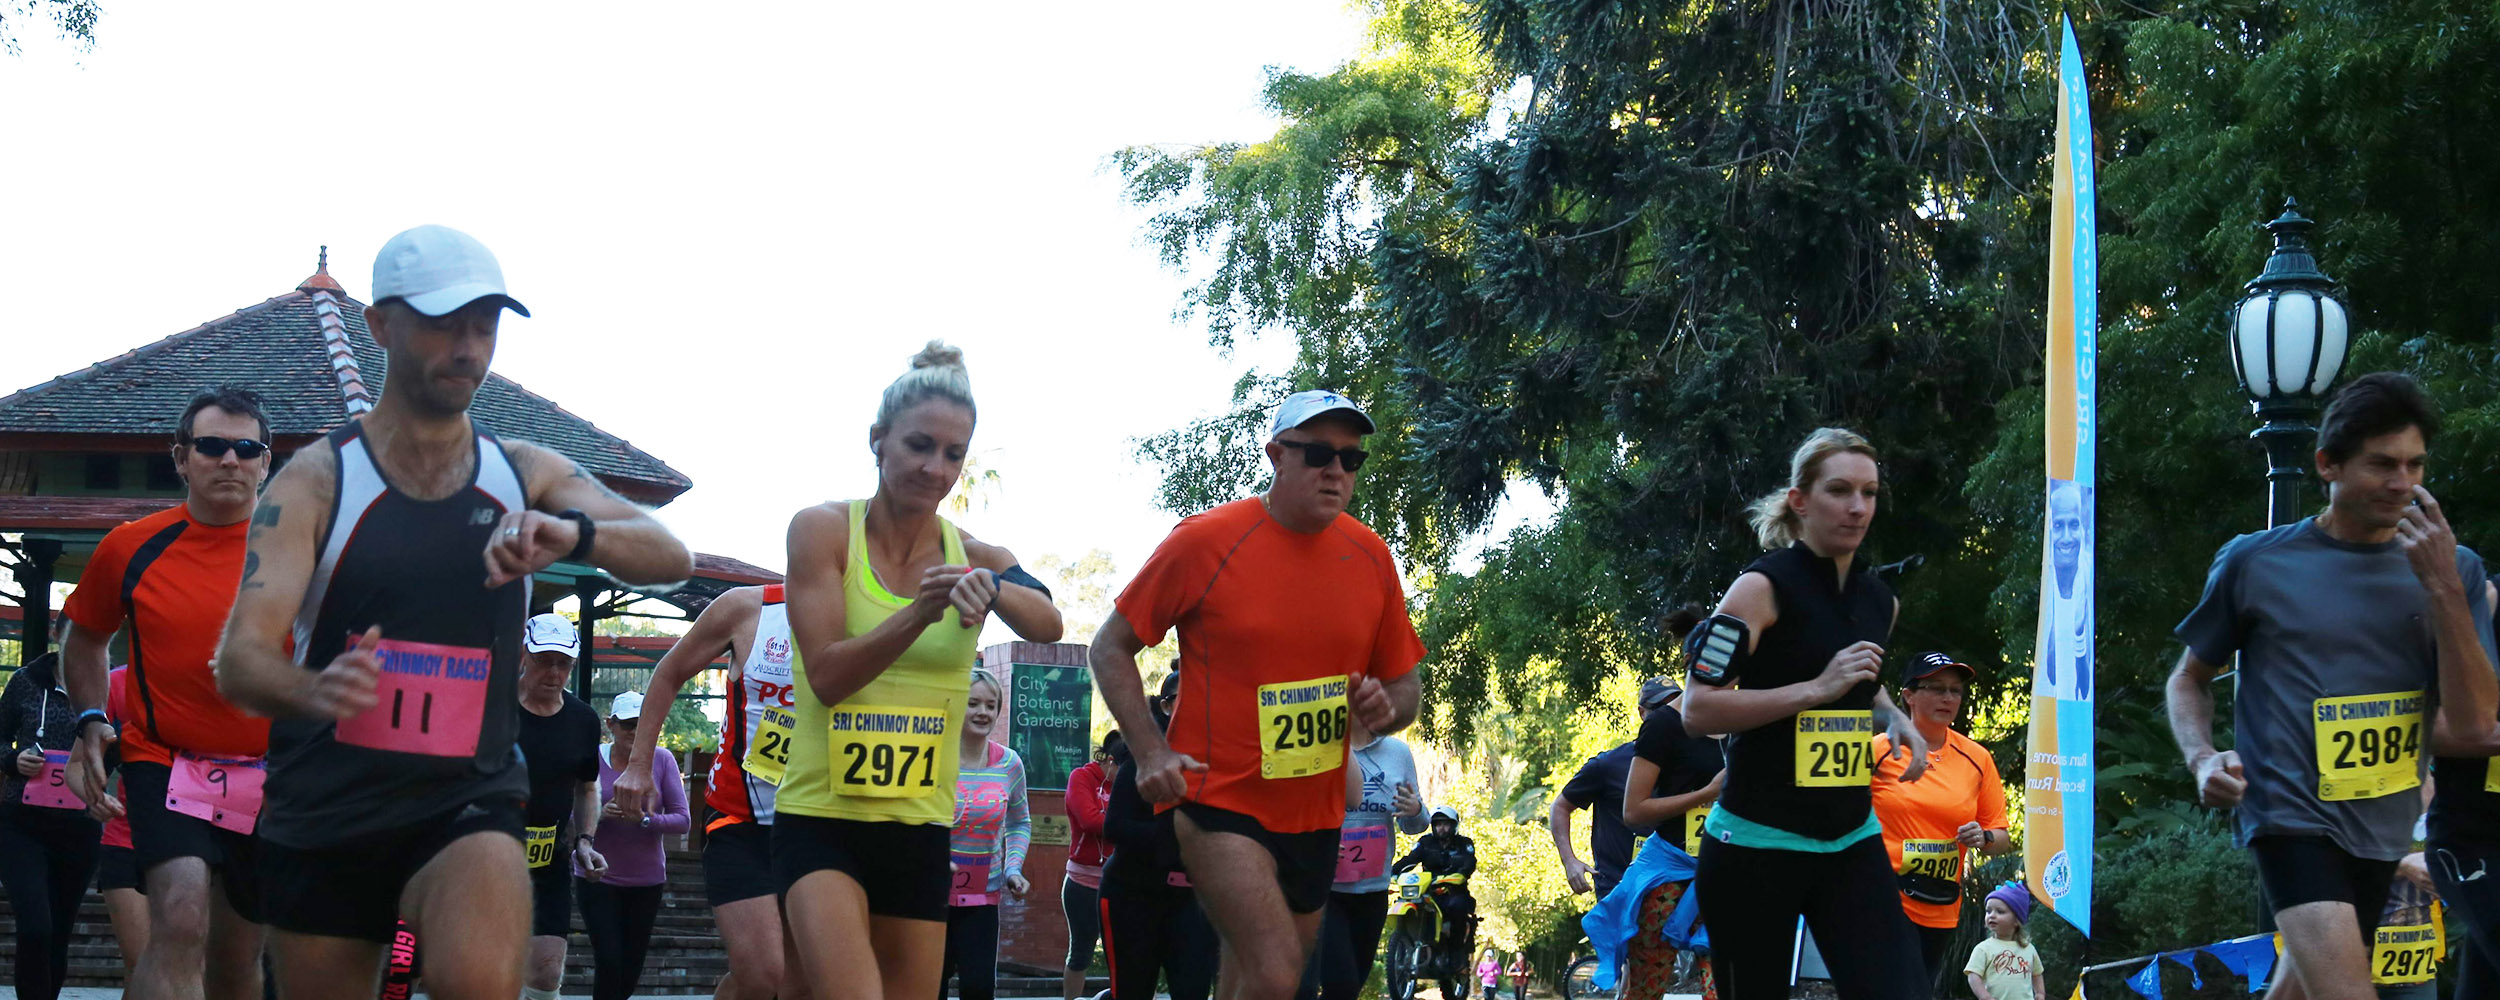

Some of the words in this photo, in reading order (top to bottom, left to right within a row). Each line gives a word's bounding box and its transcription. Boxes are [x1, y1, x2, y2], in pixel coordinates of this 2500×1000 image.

[445, 655, 489, 682] RACES
[1018, 675, 1048, 695] City
[1261, 690, 1278, 706] SRI
[1280, 685, 1321, 705] CHINMOY
[391, 688, 433, 734] 11
[1018, 694, 1074, 711] Botanic
[2317, 704, 2338, 722] SRI
[2341, 700, 2392, 720] CHINMOY
[764, 709, 779, 723] SRI
[833, 712, 853, 731] SRI
[856, 712, 910, 734] CHINMOY
[912, 715, 945, 735] RACES
[1017, 711, 1080, 729] Gardens
[1800, 717, 1815, 732] SRI
[1818, 717, 1856, 732] CHINMOY
[1273, 705, 1347, 751] 2986
[2332, 723, 2421, 770] 2984
[843, 742, 936, 787] 2971
[1809, 741, 1876, 777] 2974
[207, 768, 228, 799] 9
[1905, 842, 1916, 852] SRI
[1910, 856, 1959, 879] 2980
[2377, 931, 2390, 944] SRI
[390, 930, 416, 977] GIRL
